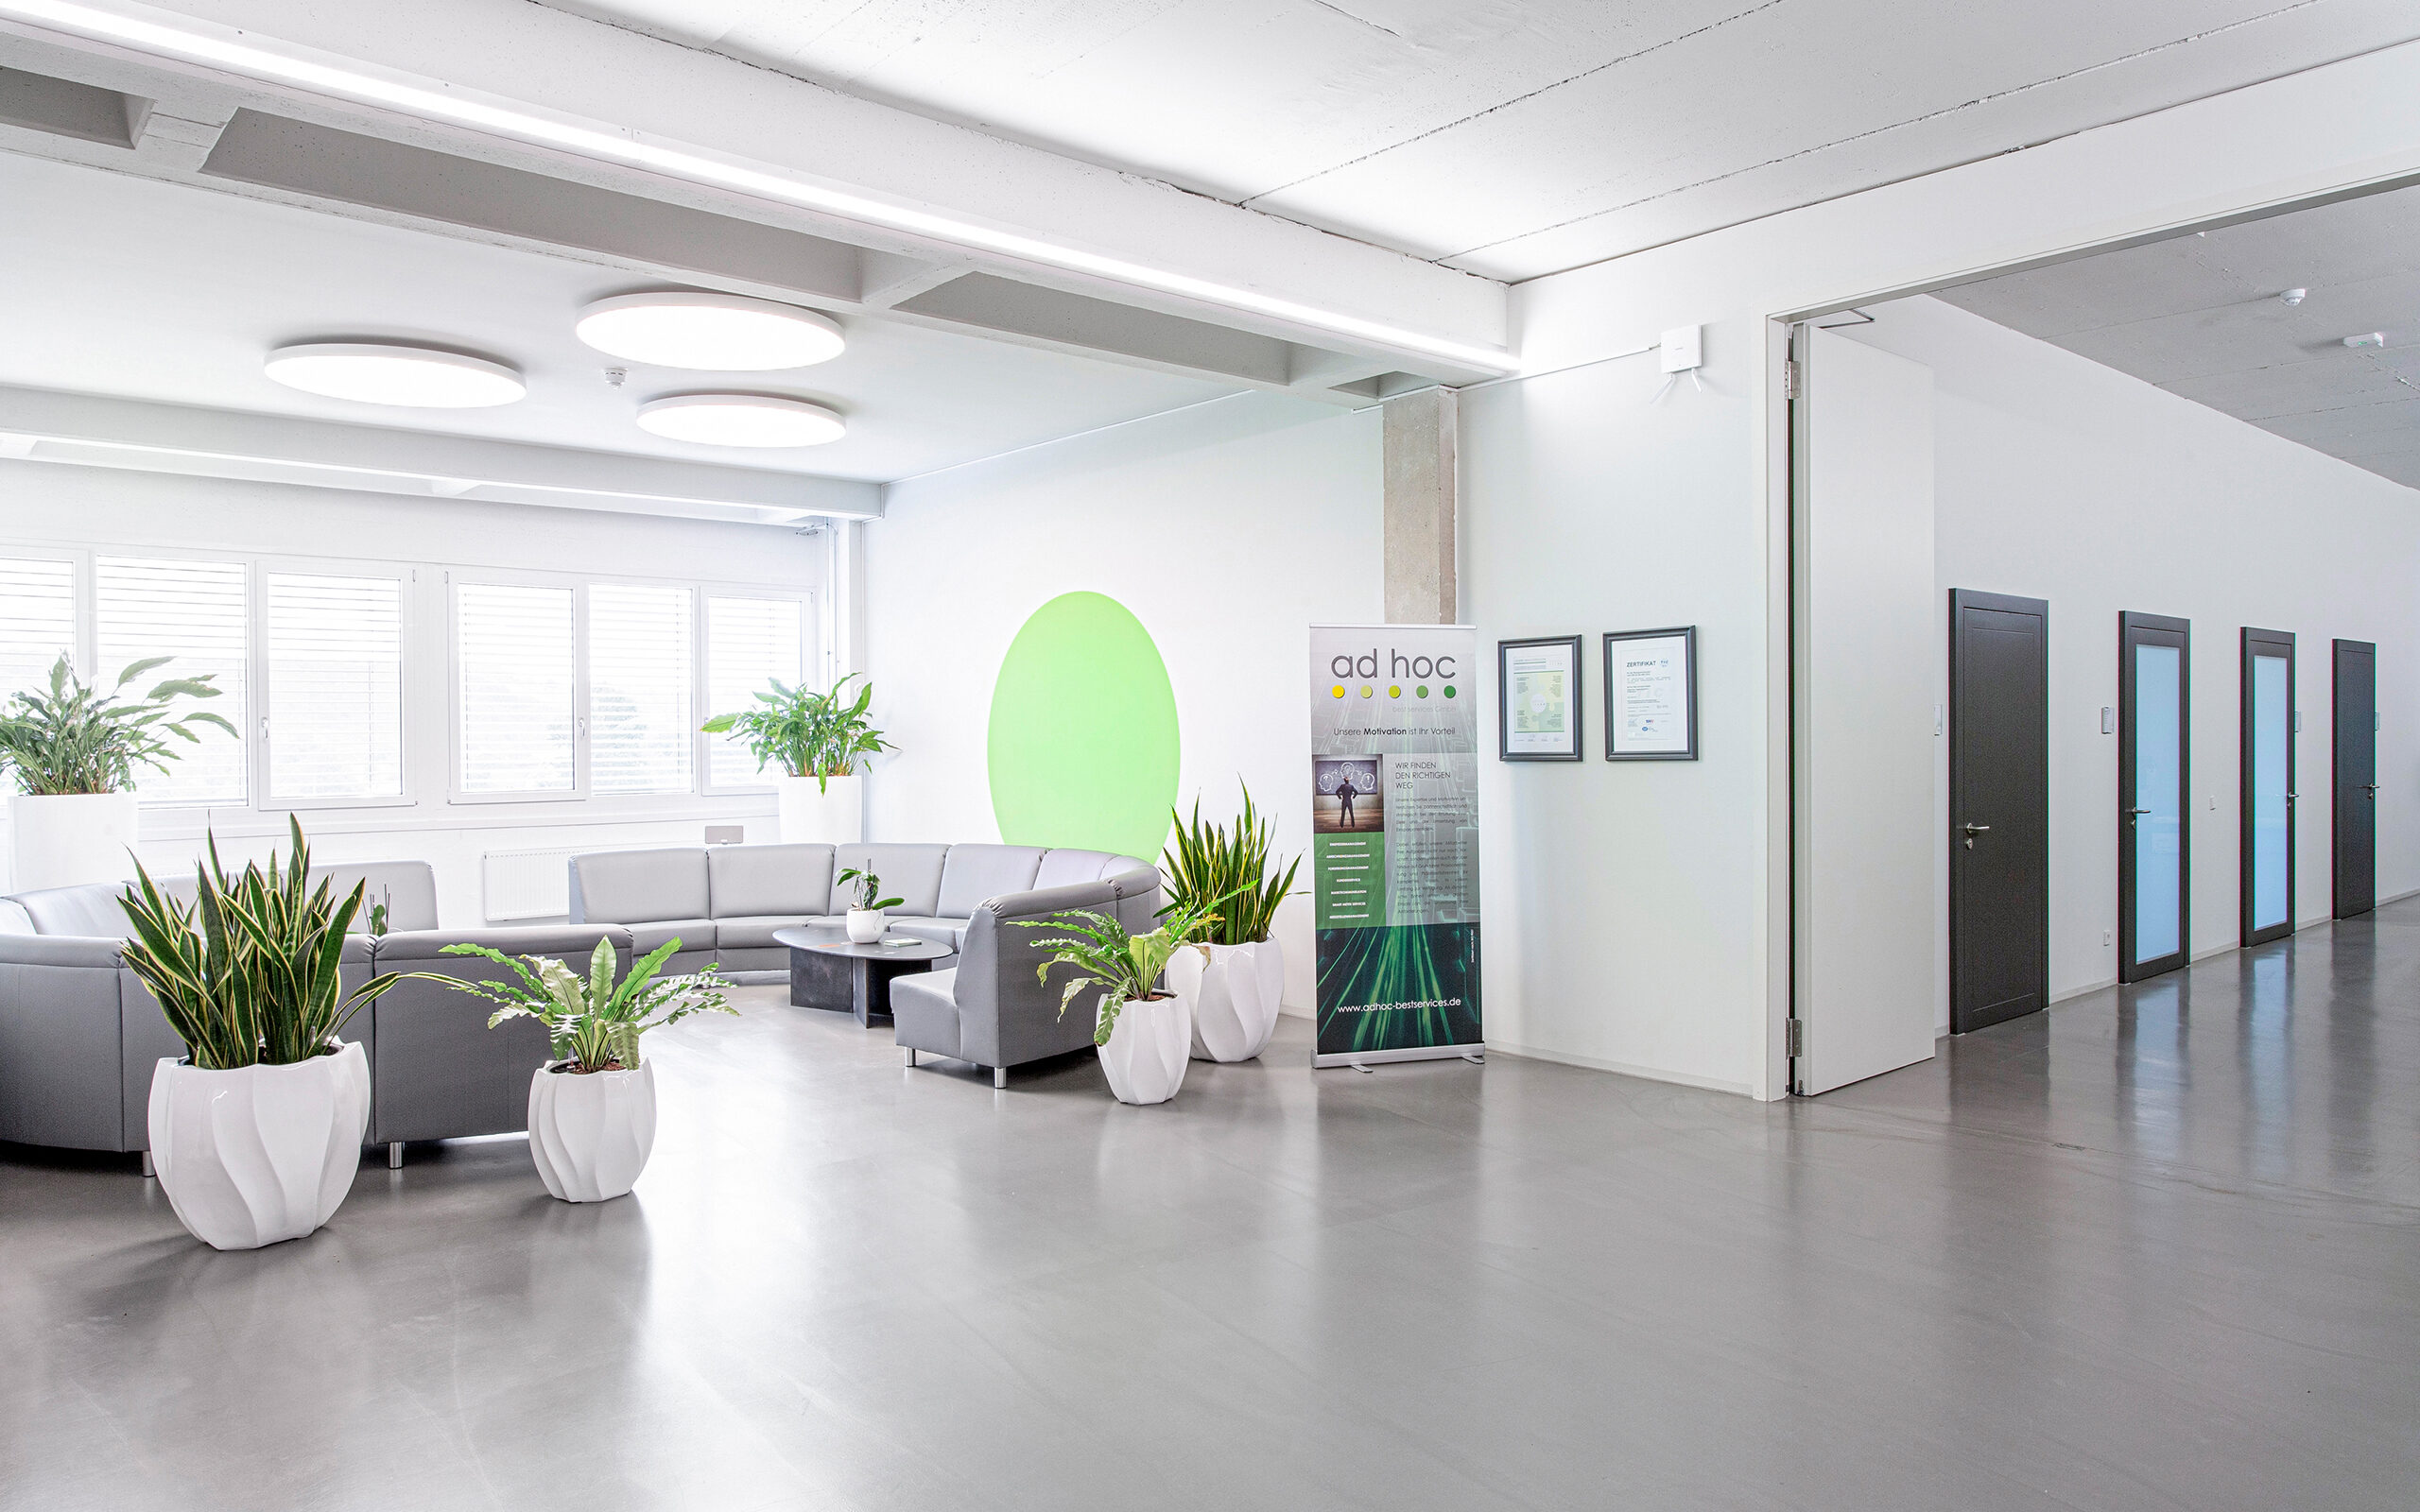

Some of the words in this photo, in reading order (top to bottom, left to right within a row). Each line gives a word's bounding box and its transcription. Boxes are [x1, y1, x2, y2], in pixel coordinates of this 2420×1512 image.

[1331, 648, 1377, 679] ad
[1391, 648, 1457, 679] hoc
[1333, 728, 1361, 736] Unsere
[1430, 727, 1456, 735] Vorteil
[1337, 997, 1461, 1013] www.adhoc-bestservices.de
